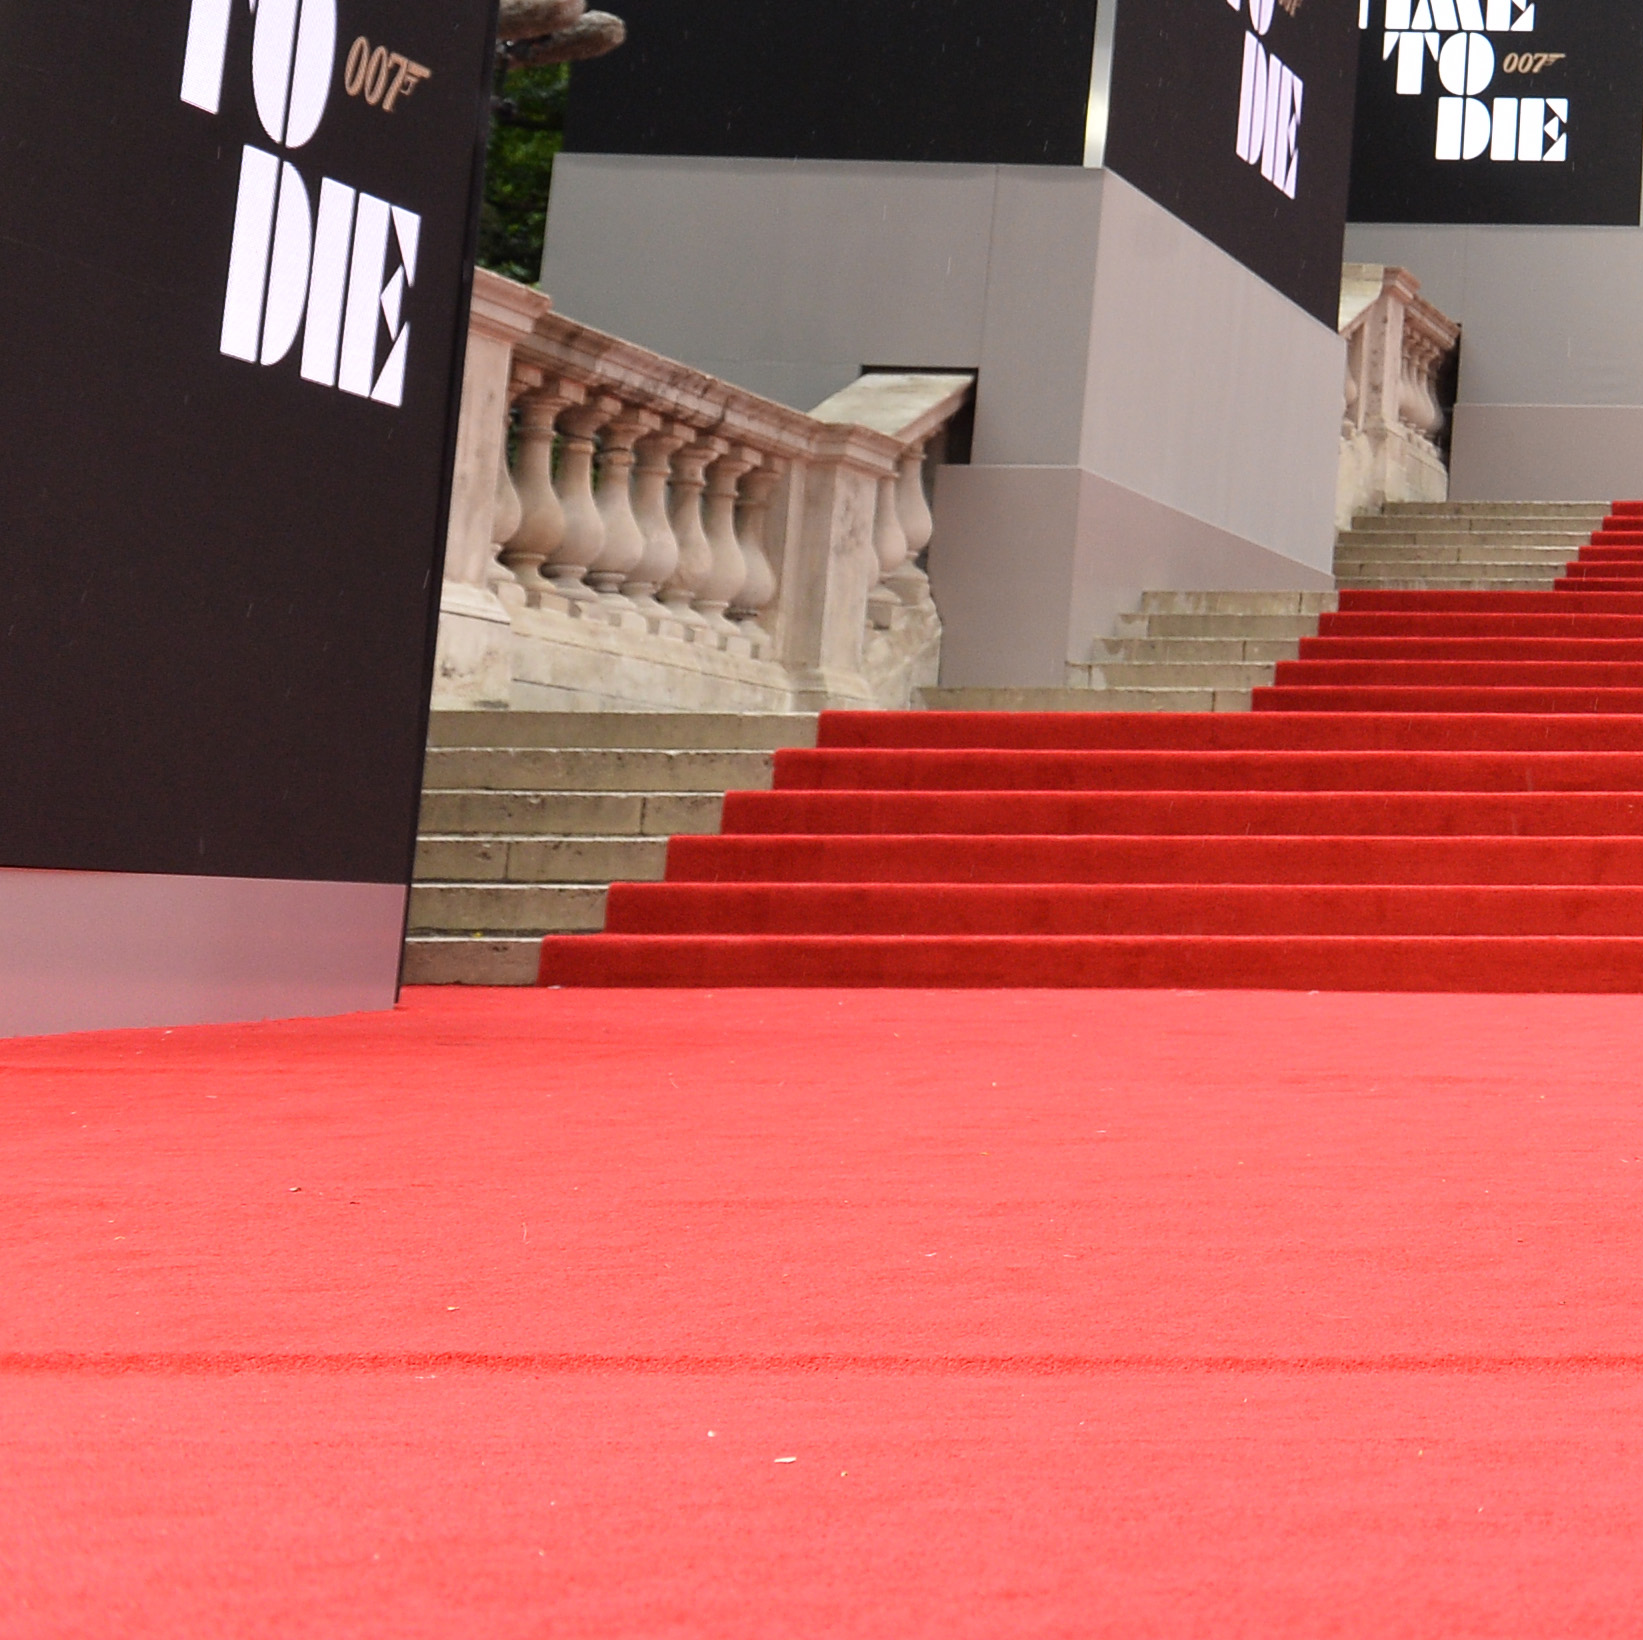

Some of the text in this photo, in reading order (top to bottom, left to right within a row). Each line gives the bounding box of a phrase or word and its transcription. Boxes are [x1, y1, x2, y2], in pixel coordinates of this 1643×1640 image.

[345, 34, 432, 112] 007
[1383, 32, 1494, 95] TO
[1502, 52, 1566, 74] 007
[1236, 31, 1303, 199] DIE
[1436, 97, 1567, 161] DIE
[220, 145, 420, 406] DIE
